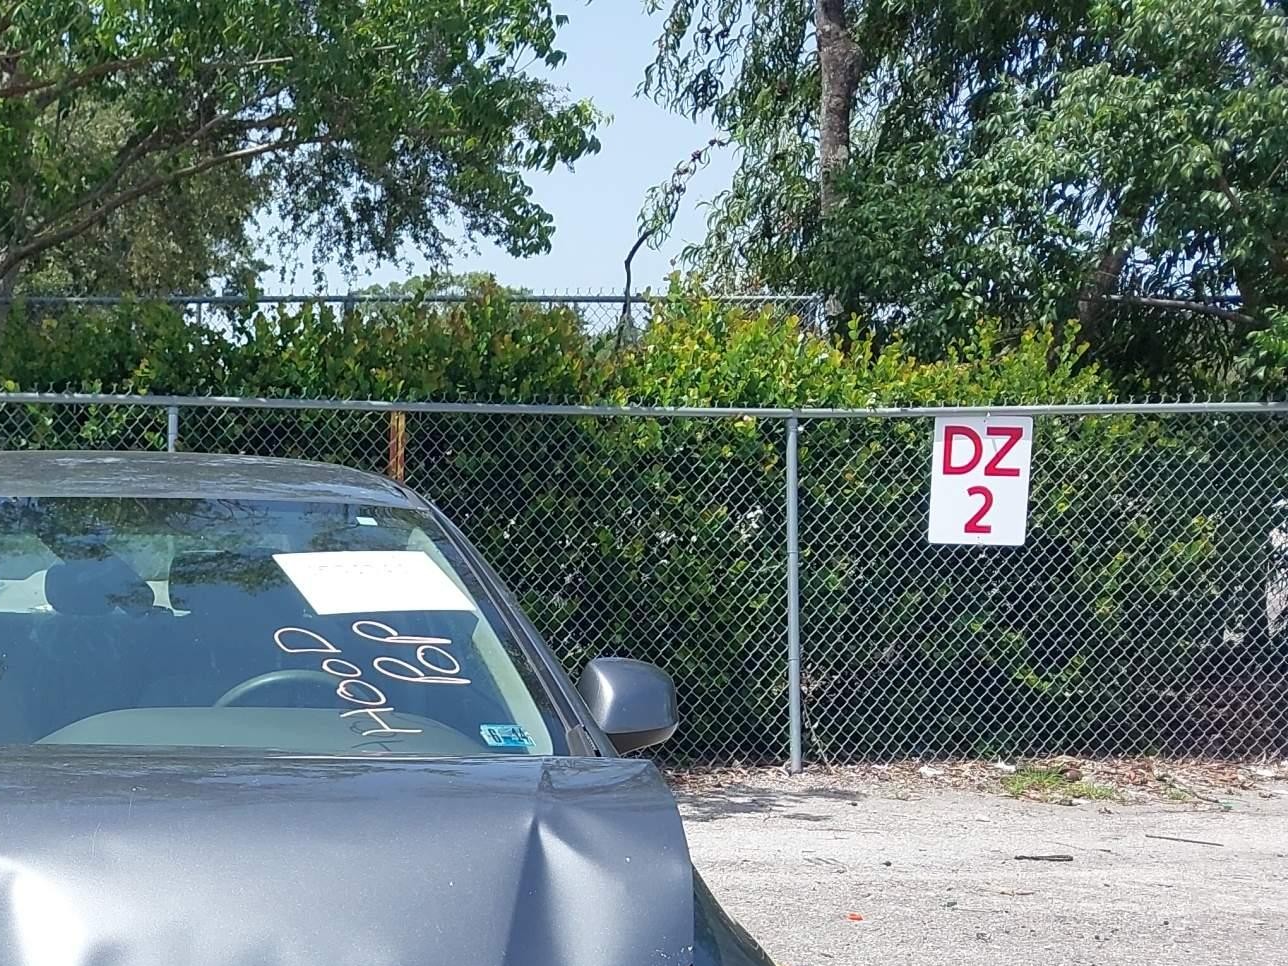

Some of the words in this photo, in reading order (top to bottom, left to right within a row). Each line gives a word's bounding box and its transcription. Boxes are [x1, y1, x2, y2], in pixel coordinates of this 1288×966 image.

[942, 425, 1024, 477] DZ
[963, 485, 994, 534] 2
[273, 626, 423, 737] HOOD
[351, 620, 472, 685] POP
